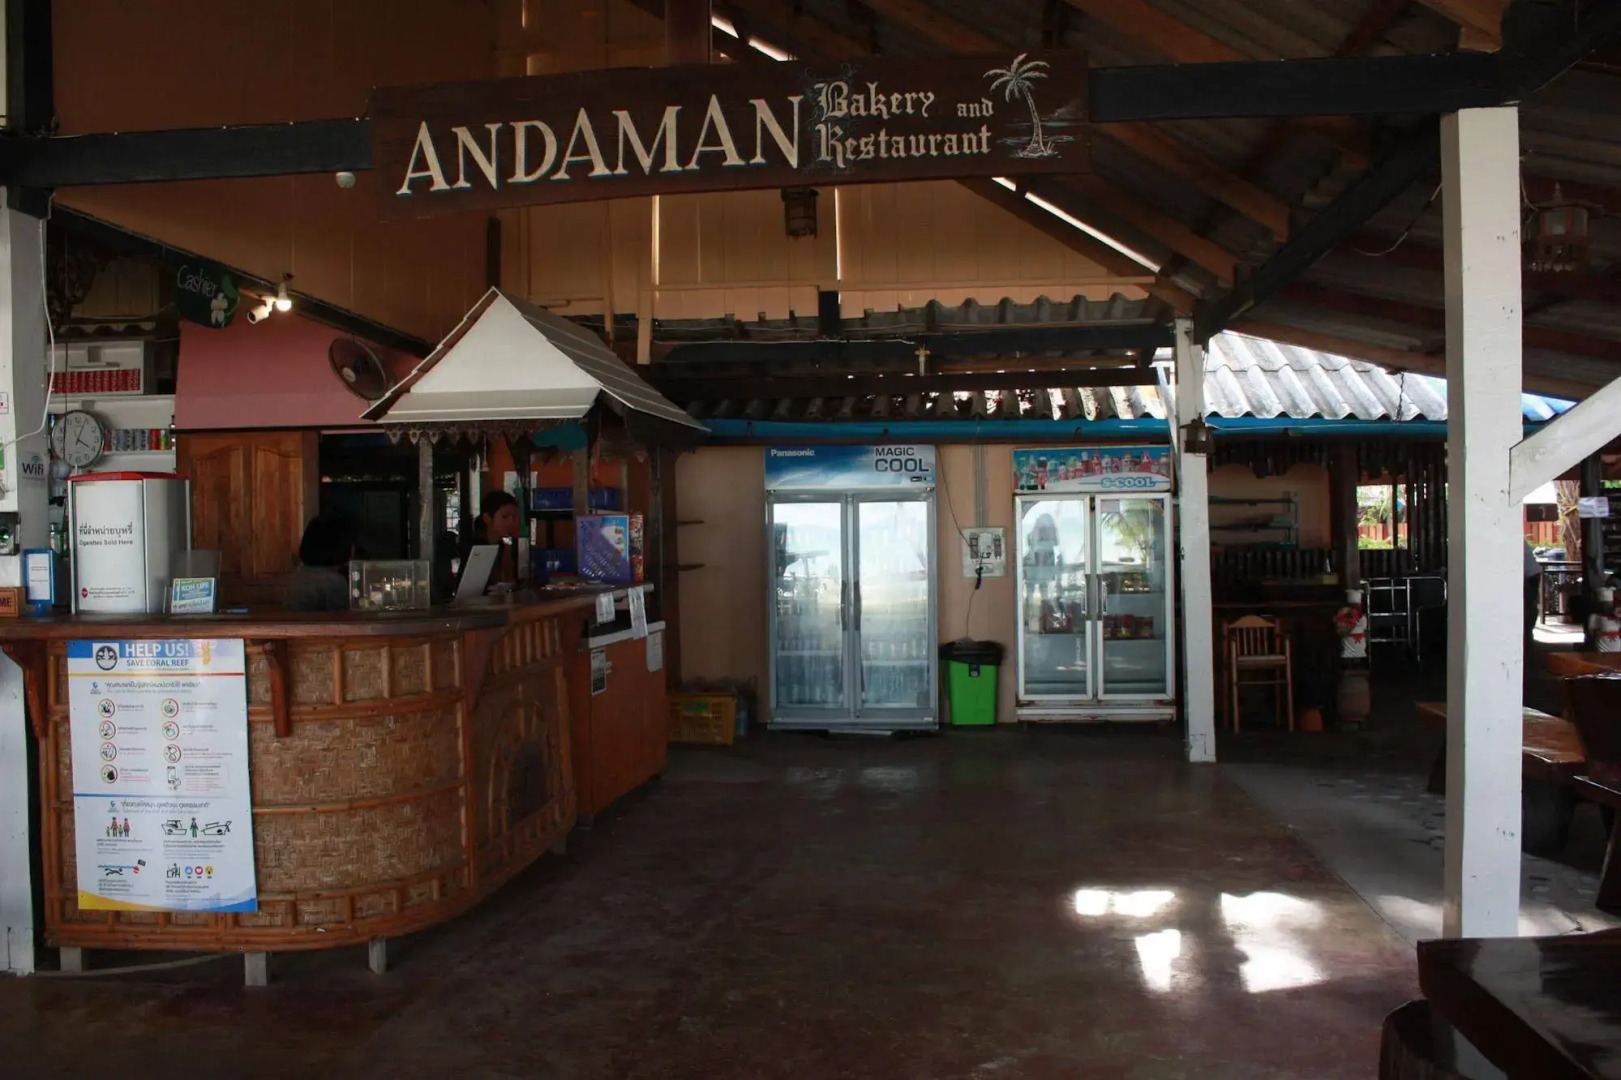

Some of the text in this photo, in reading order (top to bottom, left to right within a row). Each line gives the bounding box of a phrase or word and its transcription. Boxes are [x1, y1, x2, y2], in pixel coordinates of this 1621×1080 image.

[813, 80, 995, 121] Bakery and
[396, 93, 803, 195] ANDAMAN
[815, 122, 992, 169] Restaurant
[177, 264, 218, 297] Cashier
[770, 448, 815, 457] Panasonic
[875, 447, 915, 456] MAGIC
[22, 462, 44, 475] Wifi
[875, 458, 929, 472] COOL
[1101, 477, 1155, 488] S-COOL
[125, 642, 189, 657] HELP US!
[126, 659, 189, 667] SAVE CORAL REEF
